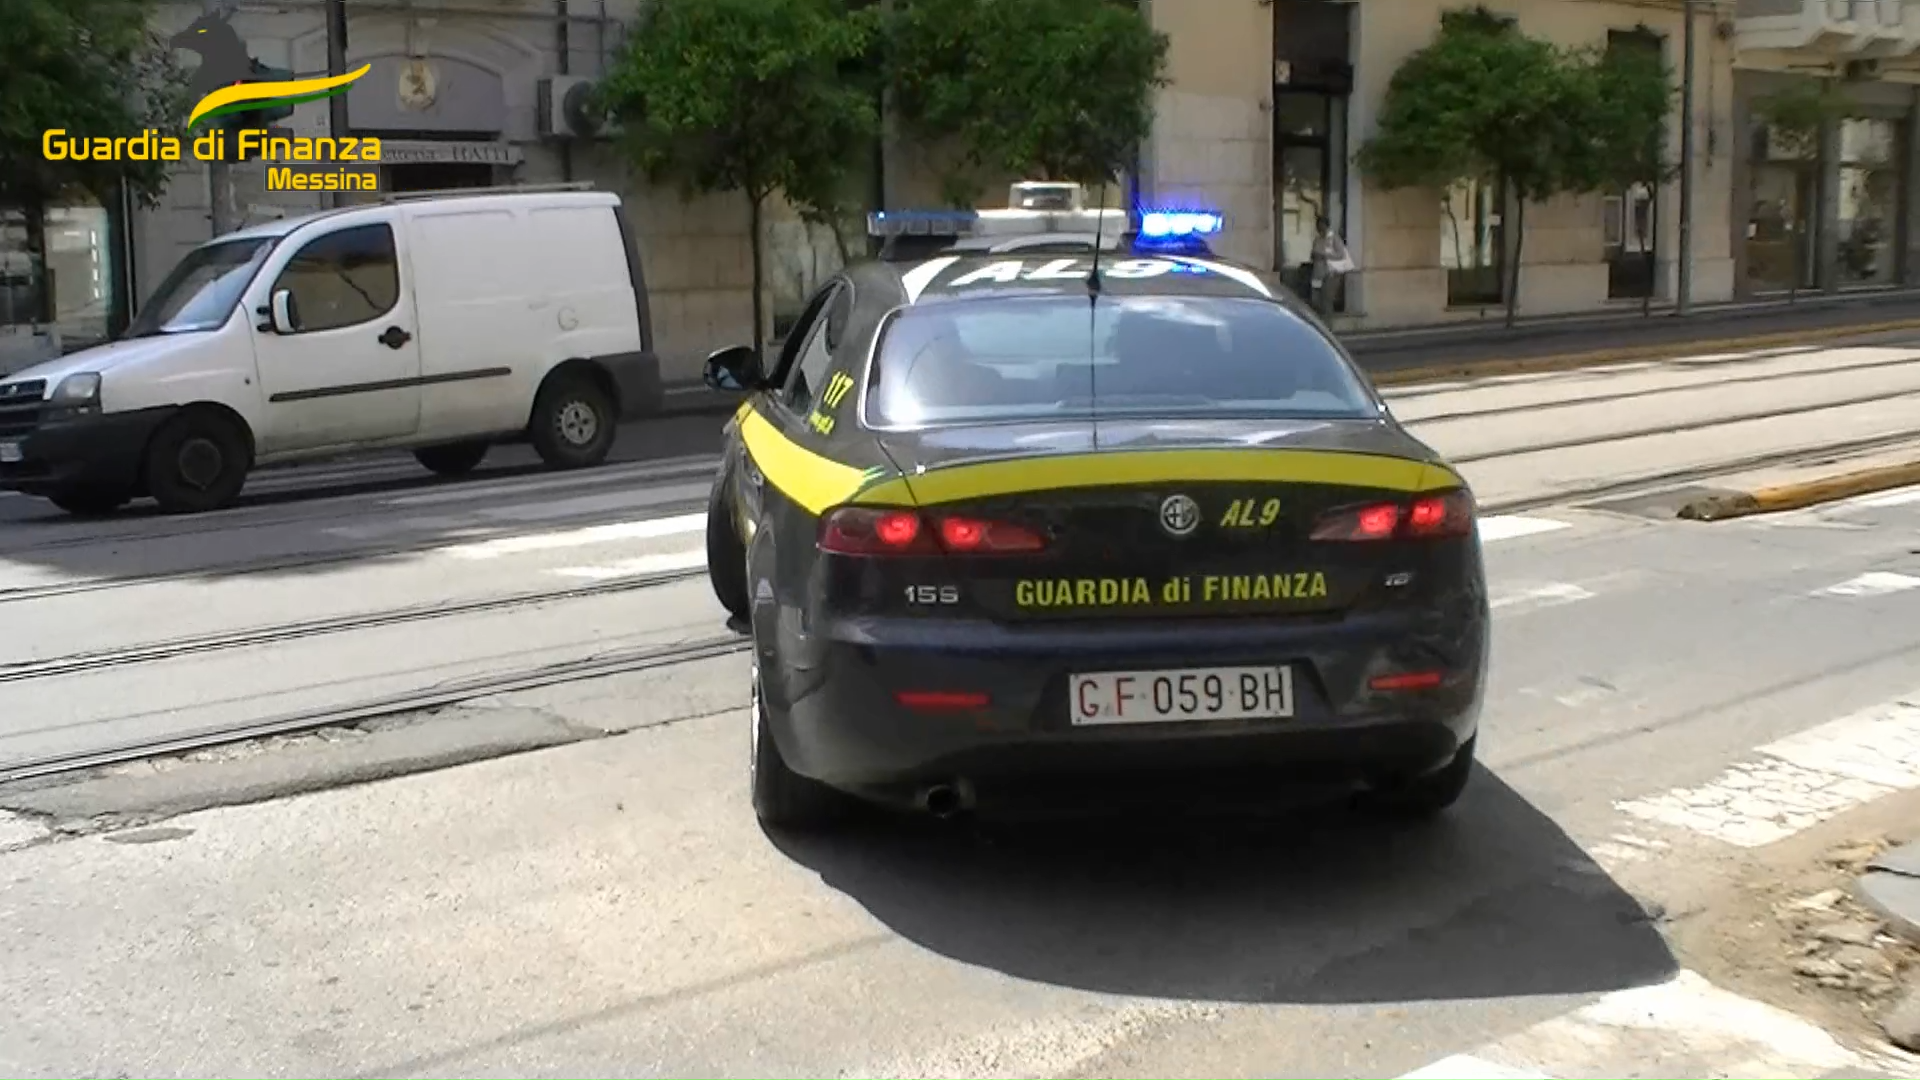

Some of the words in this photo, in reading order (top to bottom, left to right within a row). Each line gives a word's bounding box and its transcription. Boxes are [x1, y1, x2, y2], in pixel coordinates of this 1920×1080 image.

[823, 371, 854, 408] 117
[1016, 578, 1151, 606] GUARDIA
[1163, 576, 1190, 602] di
[1205, 572, 1327, 600] FINANZA
[1153, 674, 1223, 714] 059
[1239, 672, 1285, 711] BH
